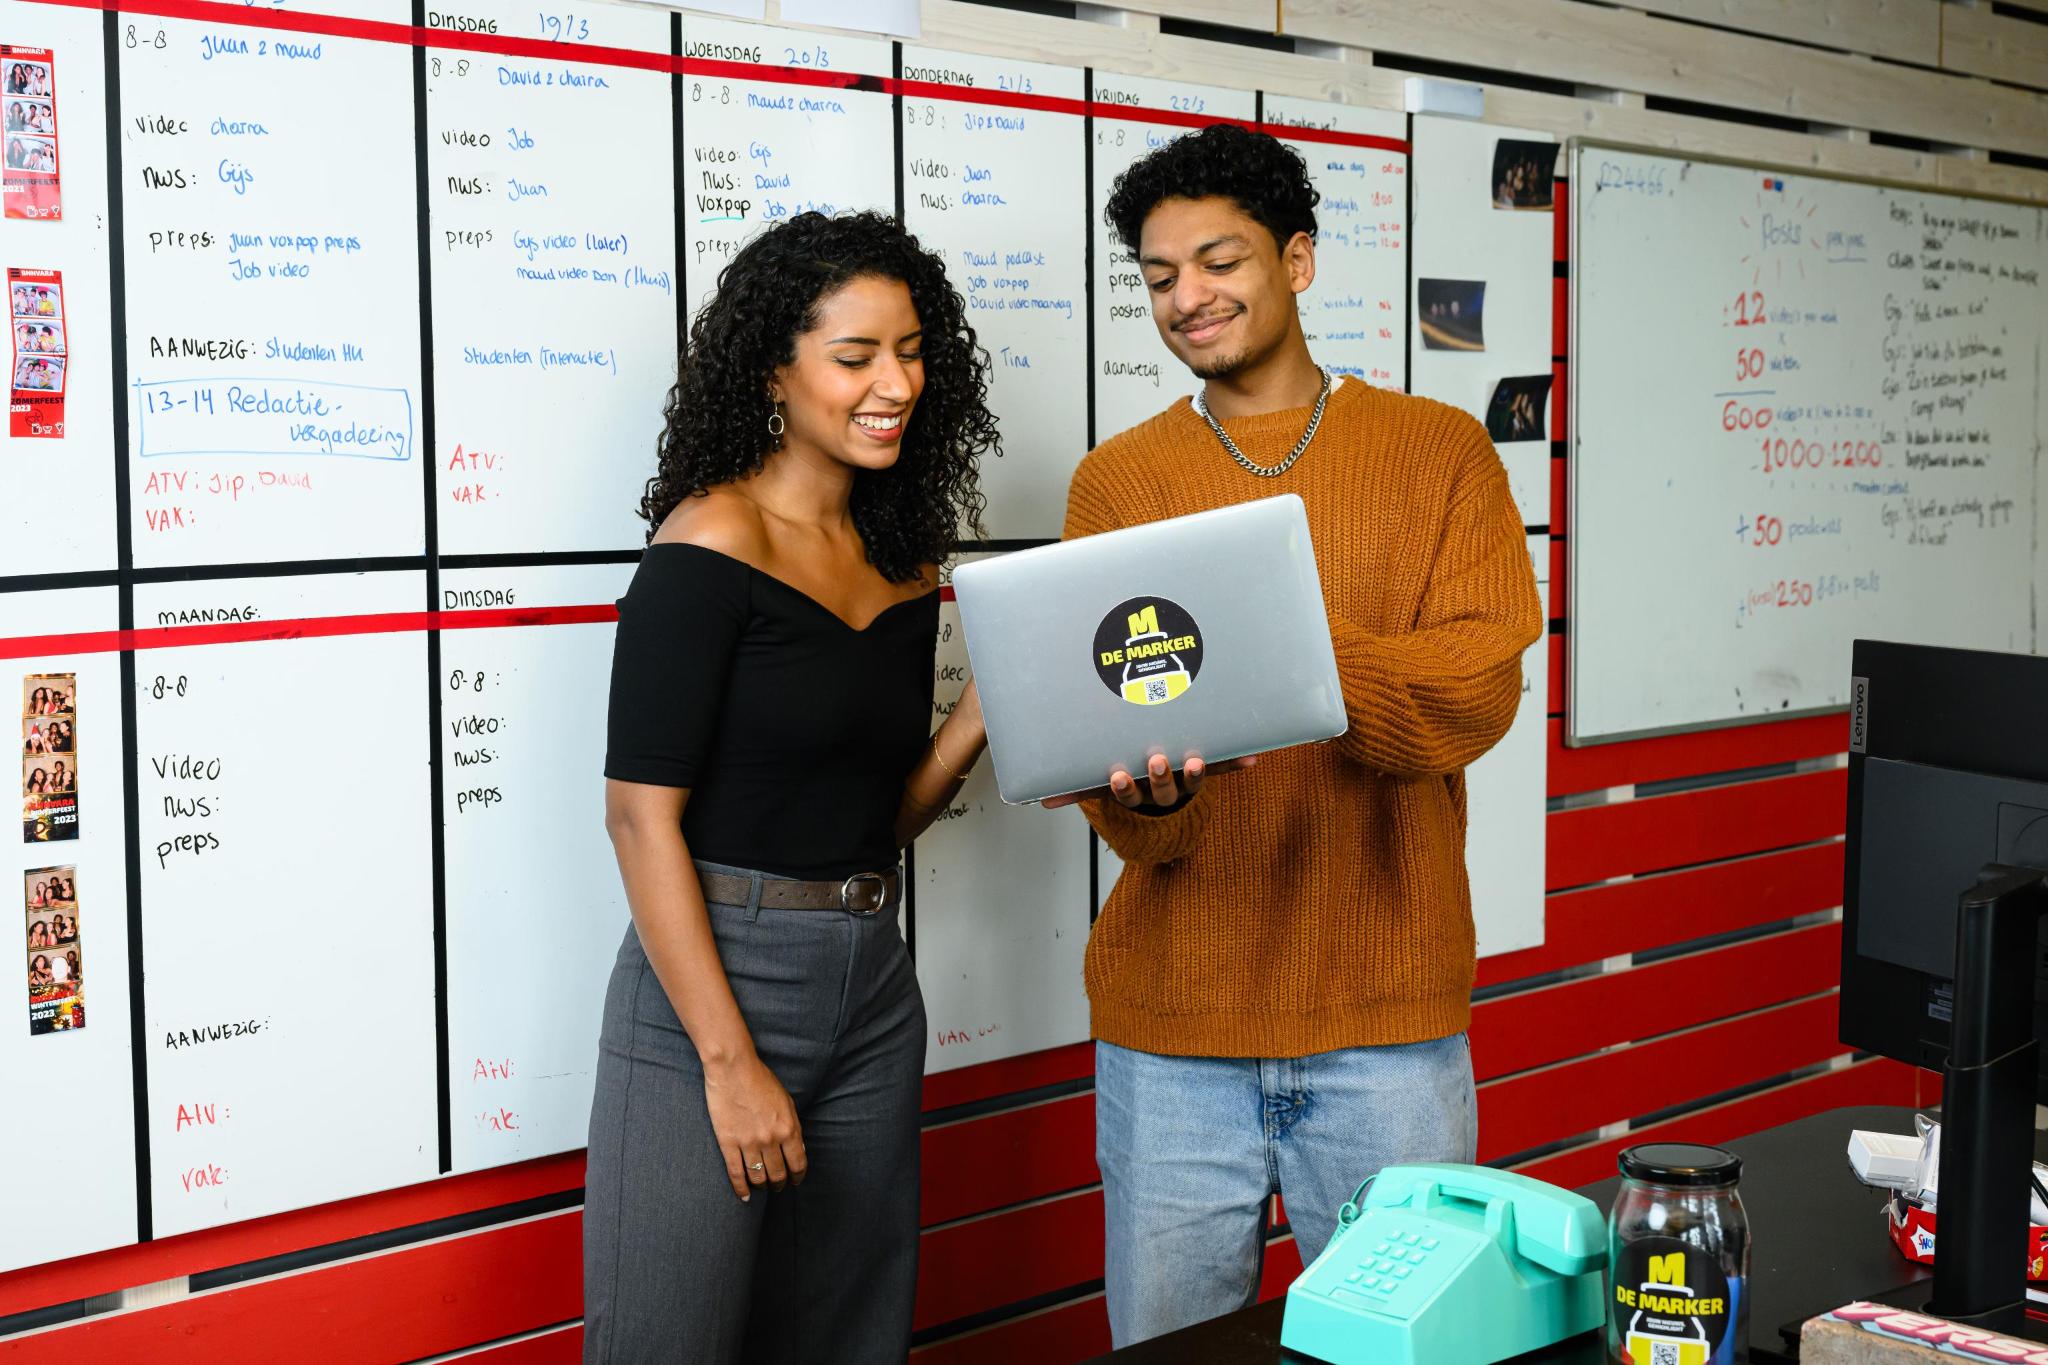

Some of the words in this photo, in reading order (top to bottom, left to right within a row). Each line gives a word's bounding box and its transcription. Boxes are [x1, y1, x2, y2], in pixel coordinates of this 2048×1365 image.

[755, 174, 790, 189] David
[1108, 273, 1142, 293] preps
[10, 397, 64, 405] ZOMERFEEST
[10, 404, 31, 412] 2023
[1722, 400, 1773, 431] 600
[1128, 605, 1160, 639] M
[1101, 650, 1124, 666] DE
[1126, 635, 1196, 661] MARKER
[1853, 683, 1864, 747] Lenovo
[458, 787, 502, 813] preps
[54, 814, 76, 824] 2023
[157, 832, 219, 869] preps
[31, 1009, 55, 1020] 2023
[1648, 1252, 1685, 1288] M
[1617, 1285, 1636, 1307] DE
[1639, 1293, 1724, 1316] MARKER
